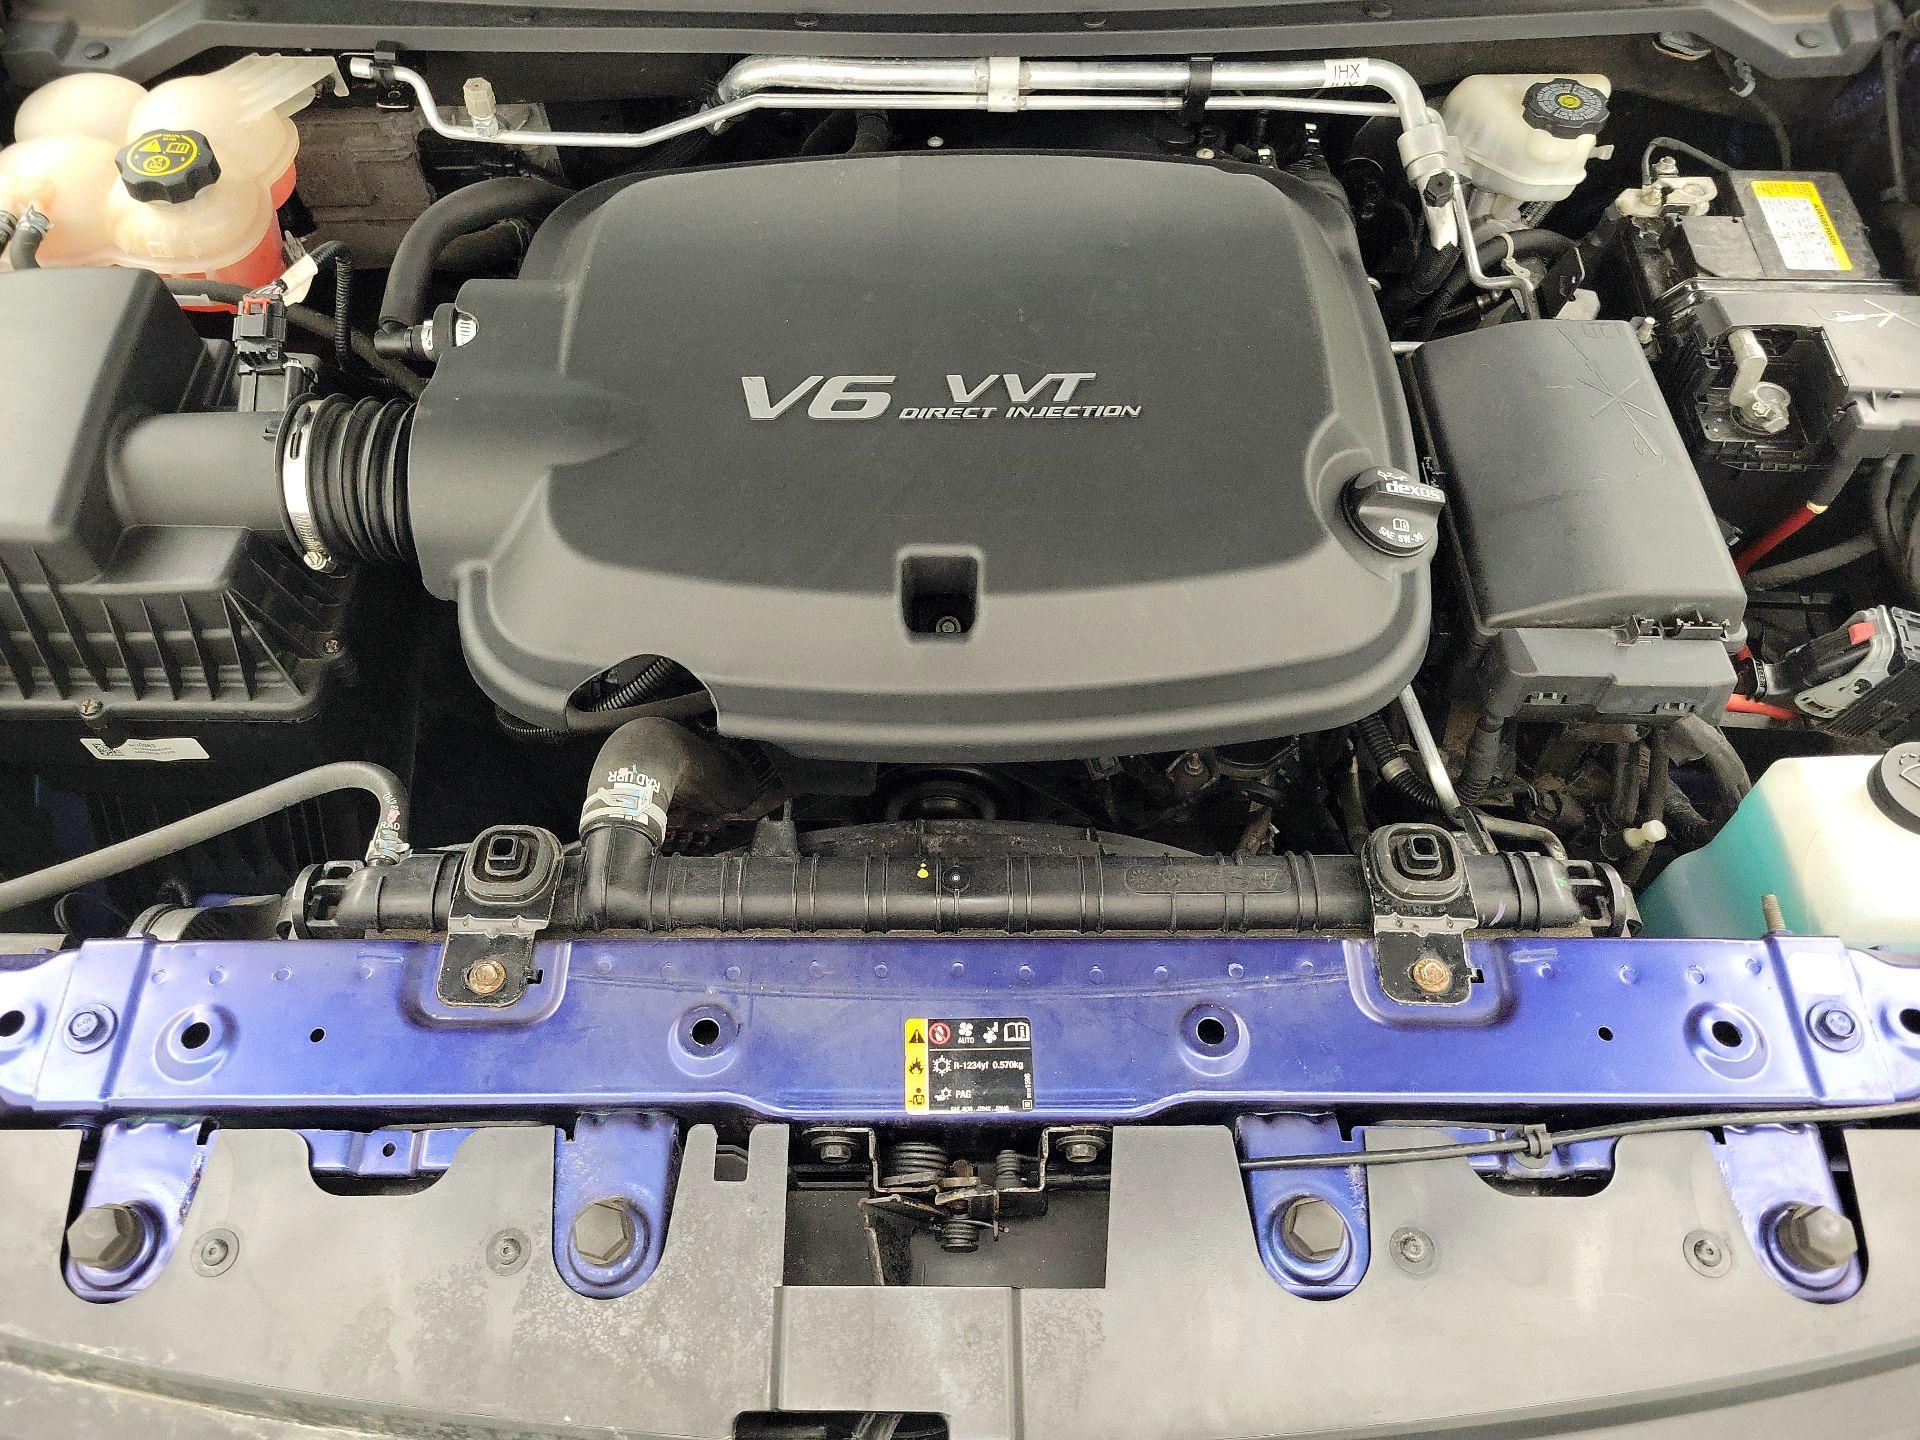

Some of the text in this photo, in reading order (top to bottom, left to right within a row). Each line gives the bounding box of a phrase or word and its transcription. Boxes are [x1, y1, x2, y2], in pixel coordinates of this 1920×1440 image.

[741, 373, 1097, 420] V6 VVT
[898, 405, 1142, 420] DIRECT INJECTION
[1385, 481, 1440, 498] dexos
[1379, 526, 1396, 540] SAE
[380, 821, 401, 831] RAD
[957, 1036, 975, 1044] AUTO
[953, 1060, 1024, 1071] R-1234yf 0.570kg
[955, 1090, 972, 1099] PAG
